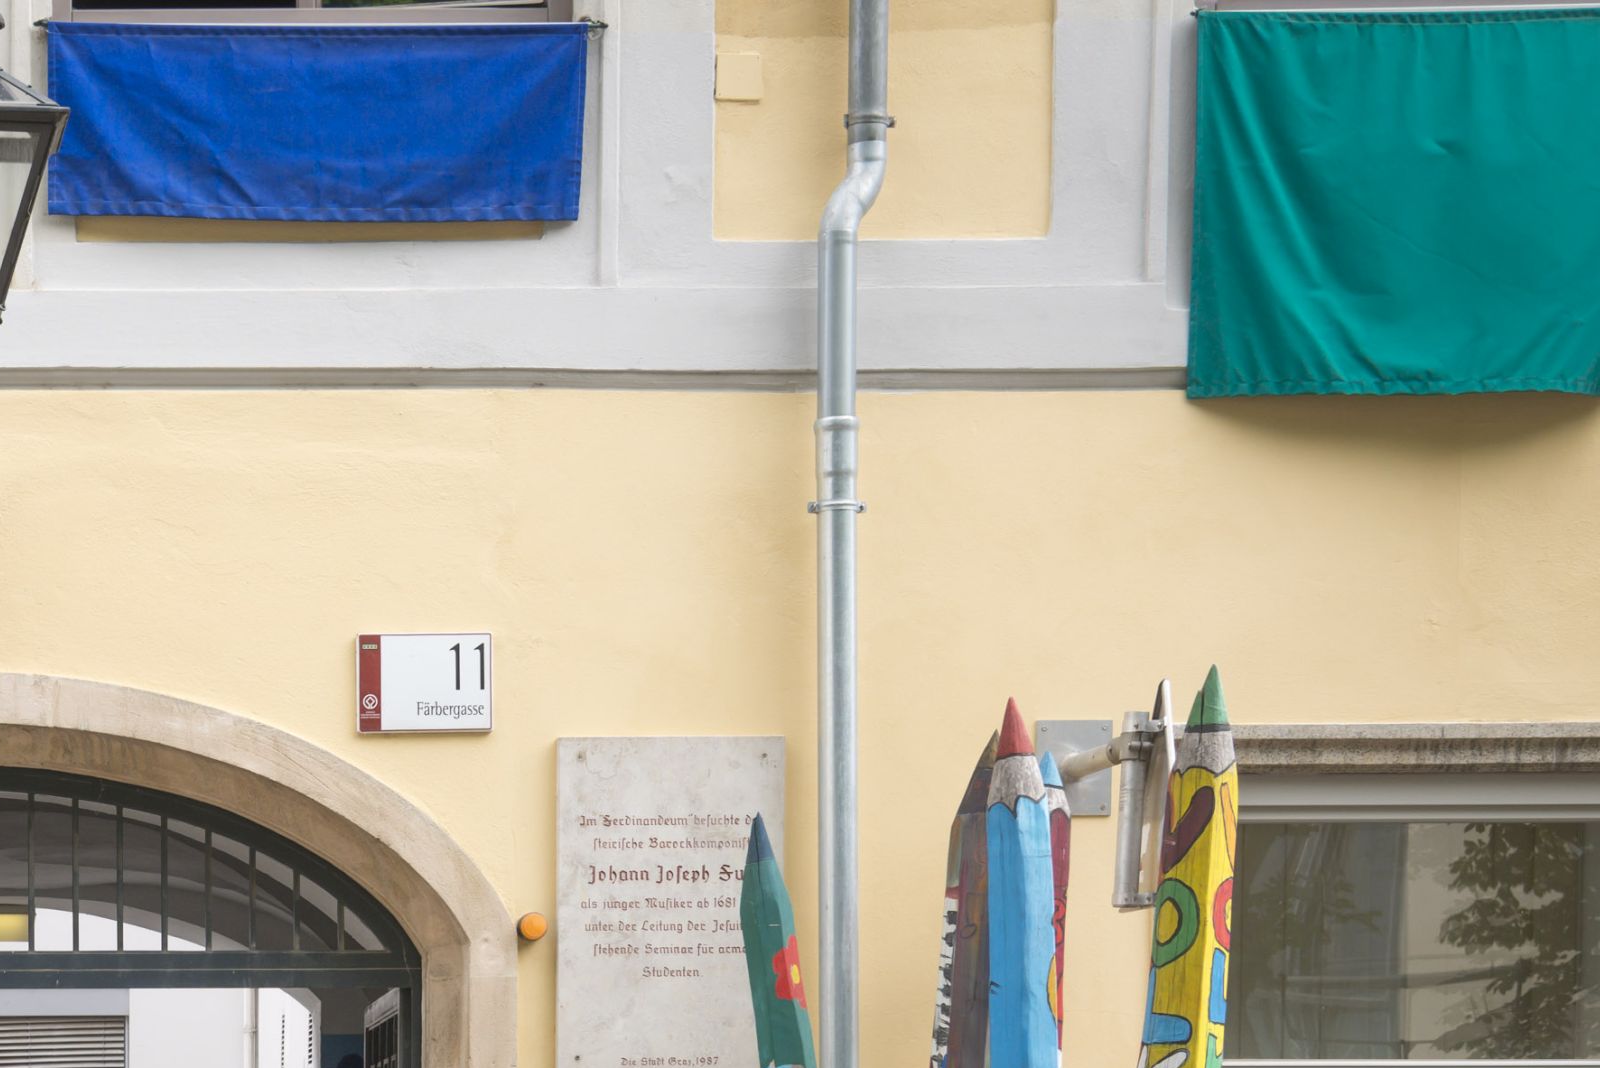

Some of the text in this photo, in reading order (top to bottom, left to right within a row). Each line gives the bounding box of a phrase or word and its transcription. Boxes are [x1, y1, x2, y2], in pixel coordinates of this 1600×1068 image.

[449, 642, 485, 690] 11
[416, 701, 485, 719] Färbergasse
[588, 864, 745, 885] Johann Joseph Fu
[580, 897, 598, 909] als
[603, 898, 640, 911] junger
[696, 896, 709, 909] ab
[713, 895, 736, 909] 1681
[584, 920, 613, 932] unter
[618, 920, 636, 932] der
[641, 919, 683, 934] Leitung
[687, 920, 706, 932] der
[644, 943, 693, 955] Seminar
[697, 943, 714, 957] für
[620, 1057, 636, 1066] Die
[641, 1056, 664, 1066] Stadt
